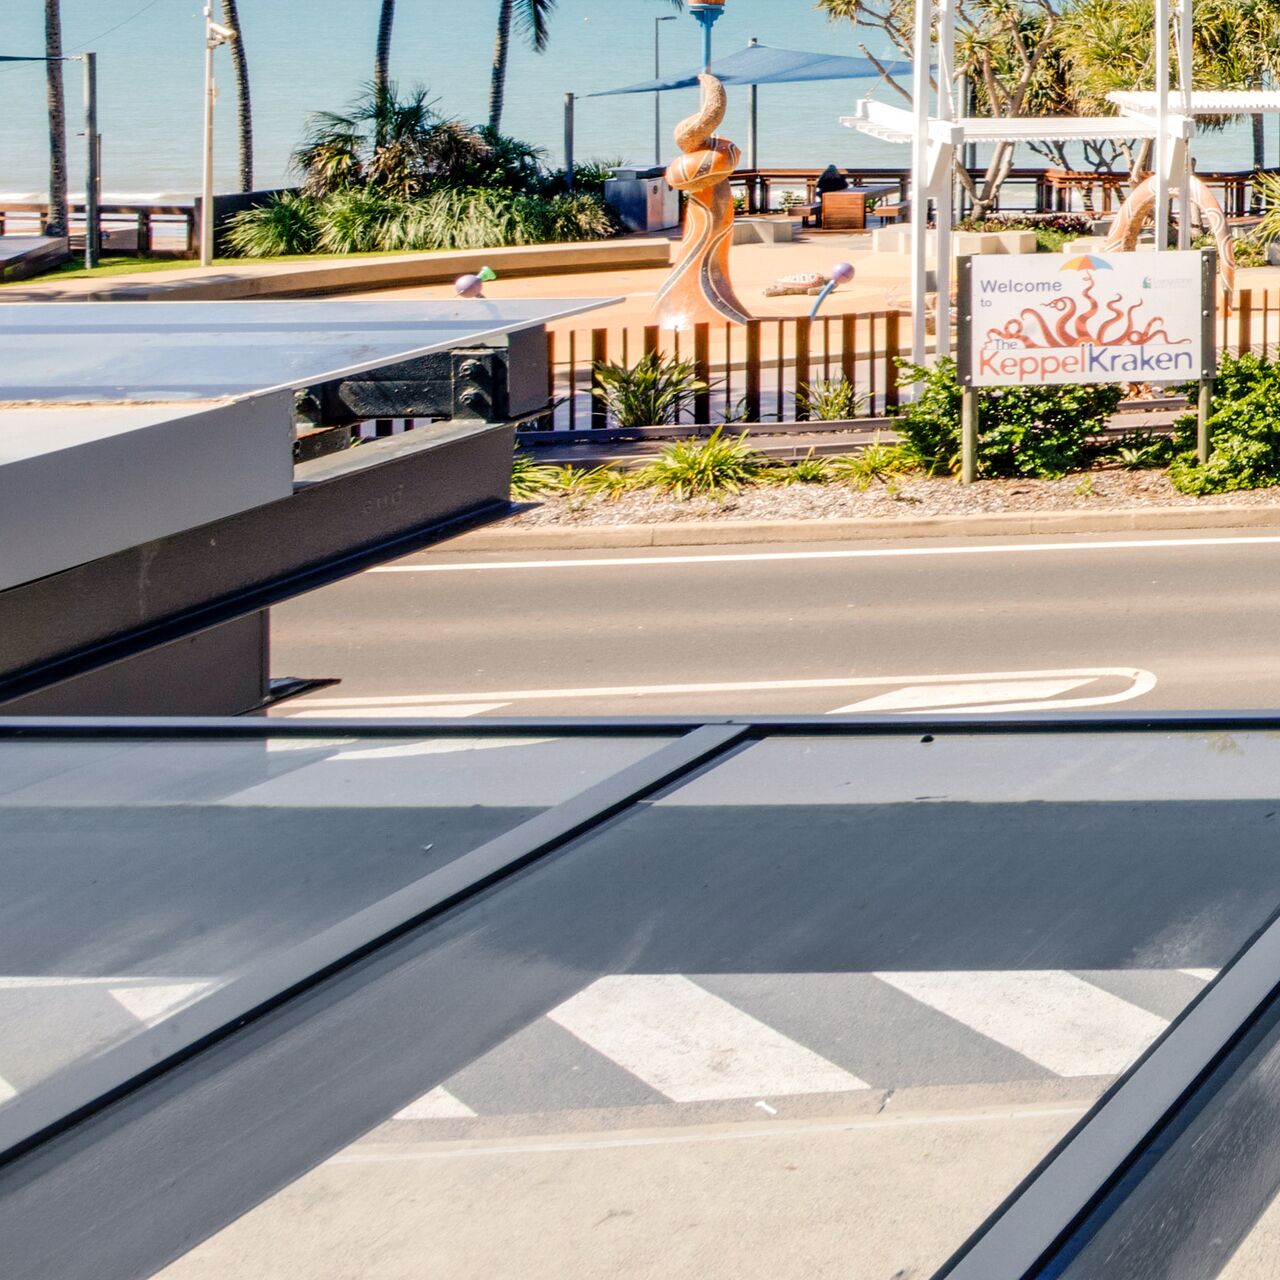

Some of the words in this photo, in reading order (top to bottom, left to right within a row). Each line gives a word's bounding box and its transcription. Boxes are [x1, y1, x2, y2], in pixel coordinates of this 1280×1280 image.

[980, 279, 1062, 293] Welcome
[980, 299, 993, 307] to
[993, 339, 1018, 350] The
